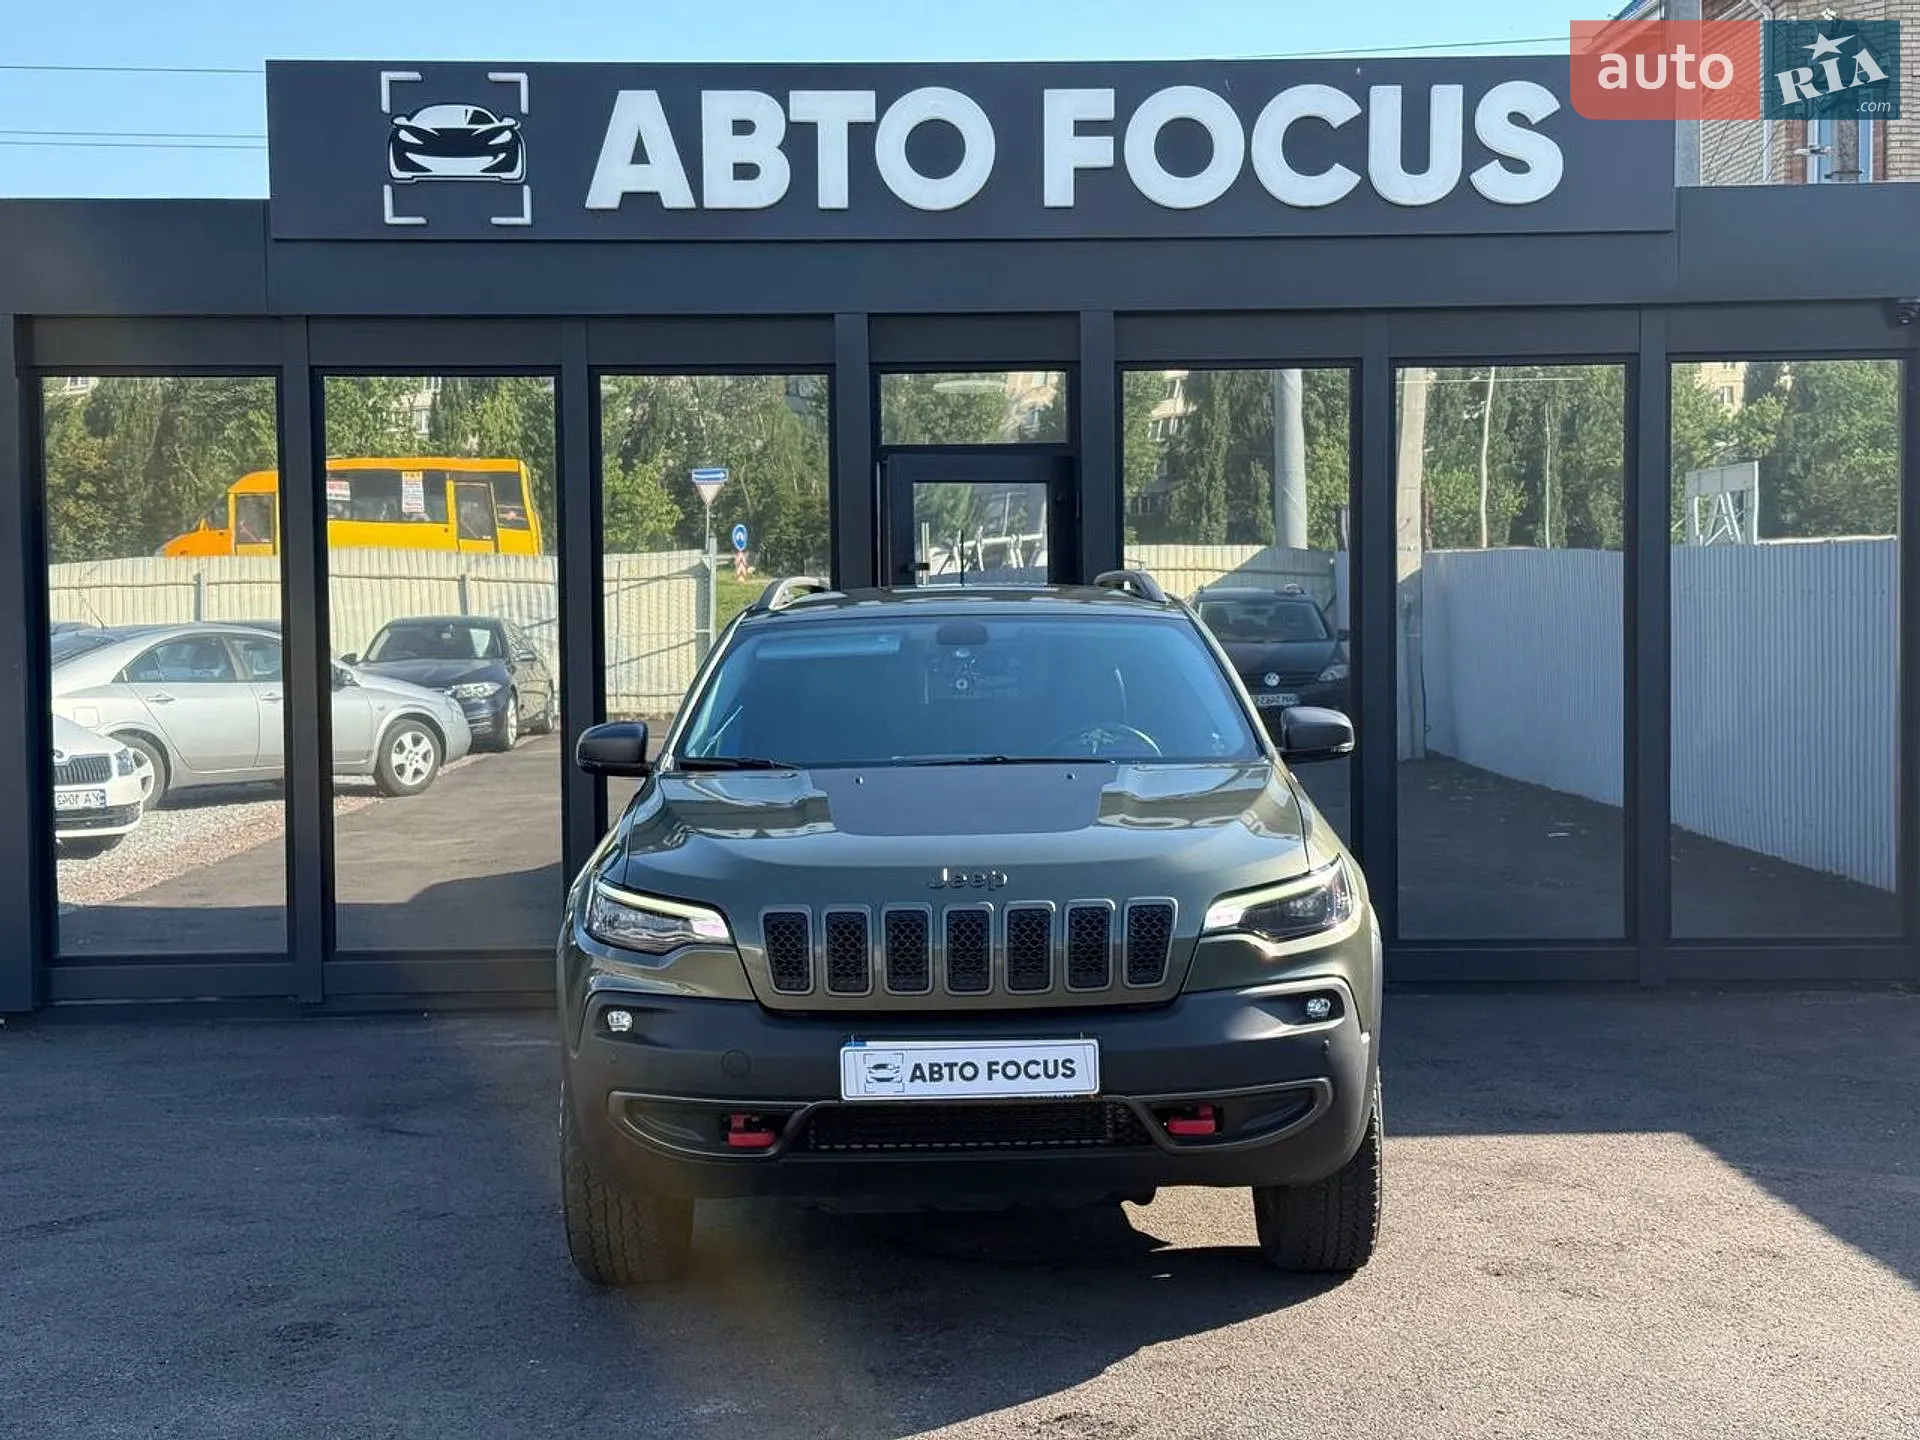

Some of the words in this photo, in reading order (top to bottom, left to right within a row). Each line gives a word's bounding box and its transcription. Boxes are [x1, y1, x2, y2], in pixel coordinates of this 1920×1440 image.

[585, 86, 996, 211] АВТО
[1043, 80, 1564, 209] FOCUS
[925, 866, 1008, 892] Jeep
[908, 1060, 980, 1084] АВТО
[986, 1057, 1077, 1082] FOCUS
